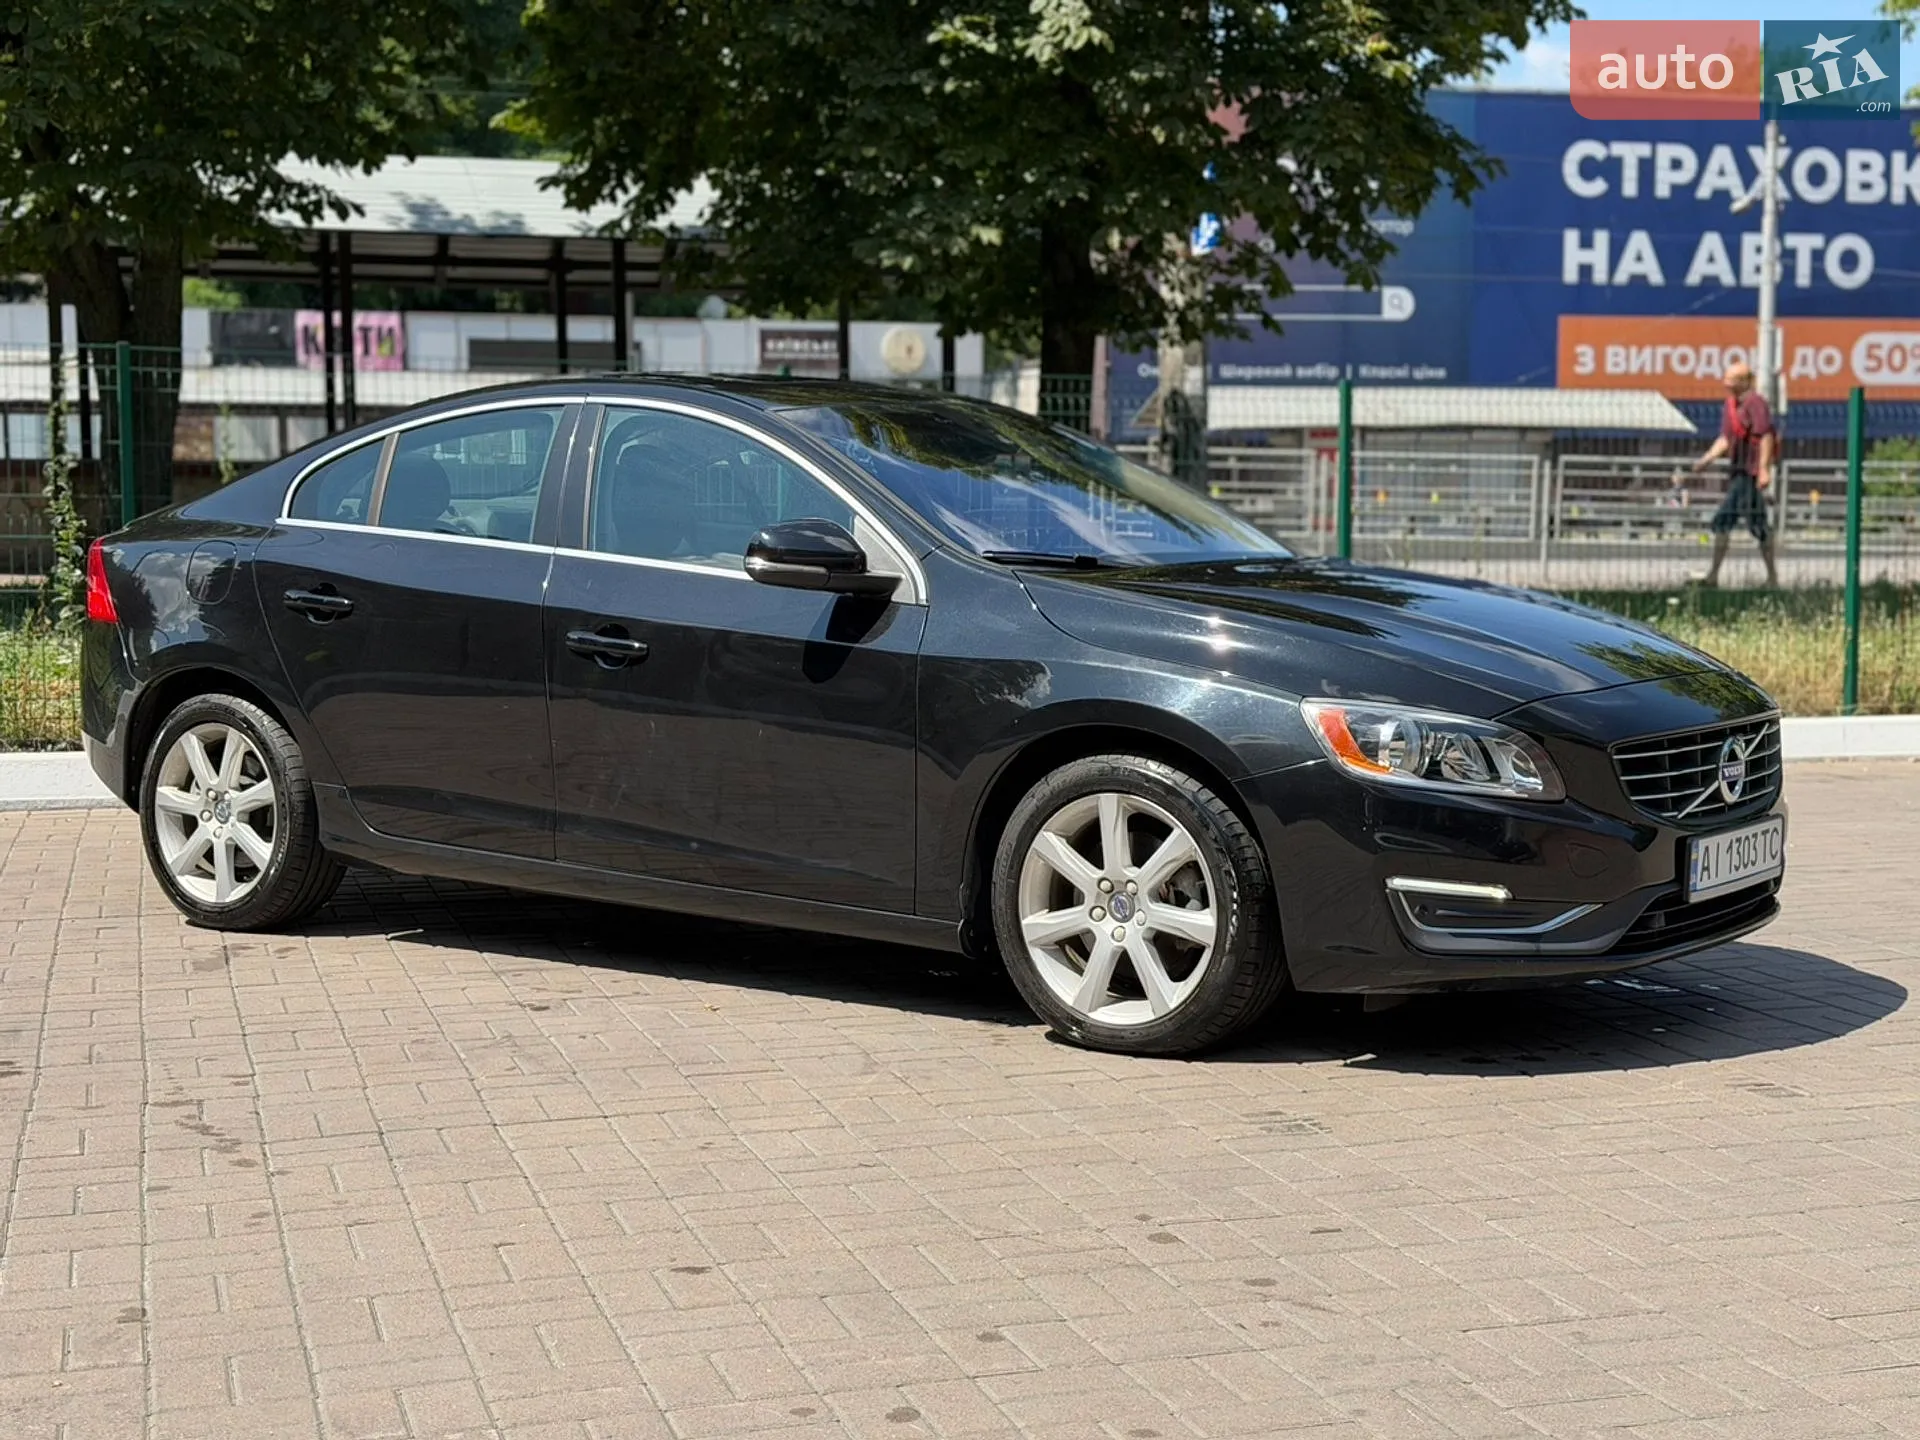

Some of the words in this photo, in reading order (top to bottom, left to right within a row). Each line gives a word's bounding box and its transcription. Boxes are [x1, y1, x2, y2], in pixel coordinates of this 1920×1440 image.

[1562, 228, 1667, 286] НА
[1684, 231, 1876, 291] АВТО
[1573, 344, 1596, 375] З
[1790, 345, 1843, 380] ДО
[1726, 832, 1759, 875] 1303
